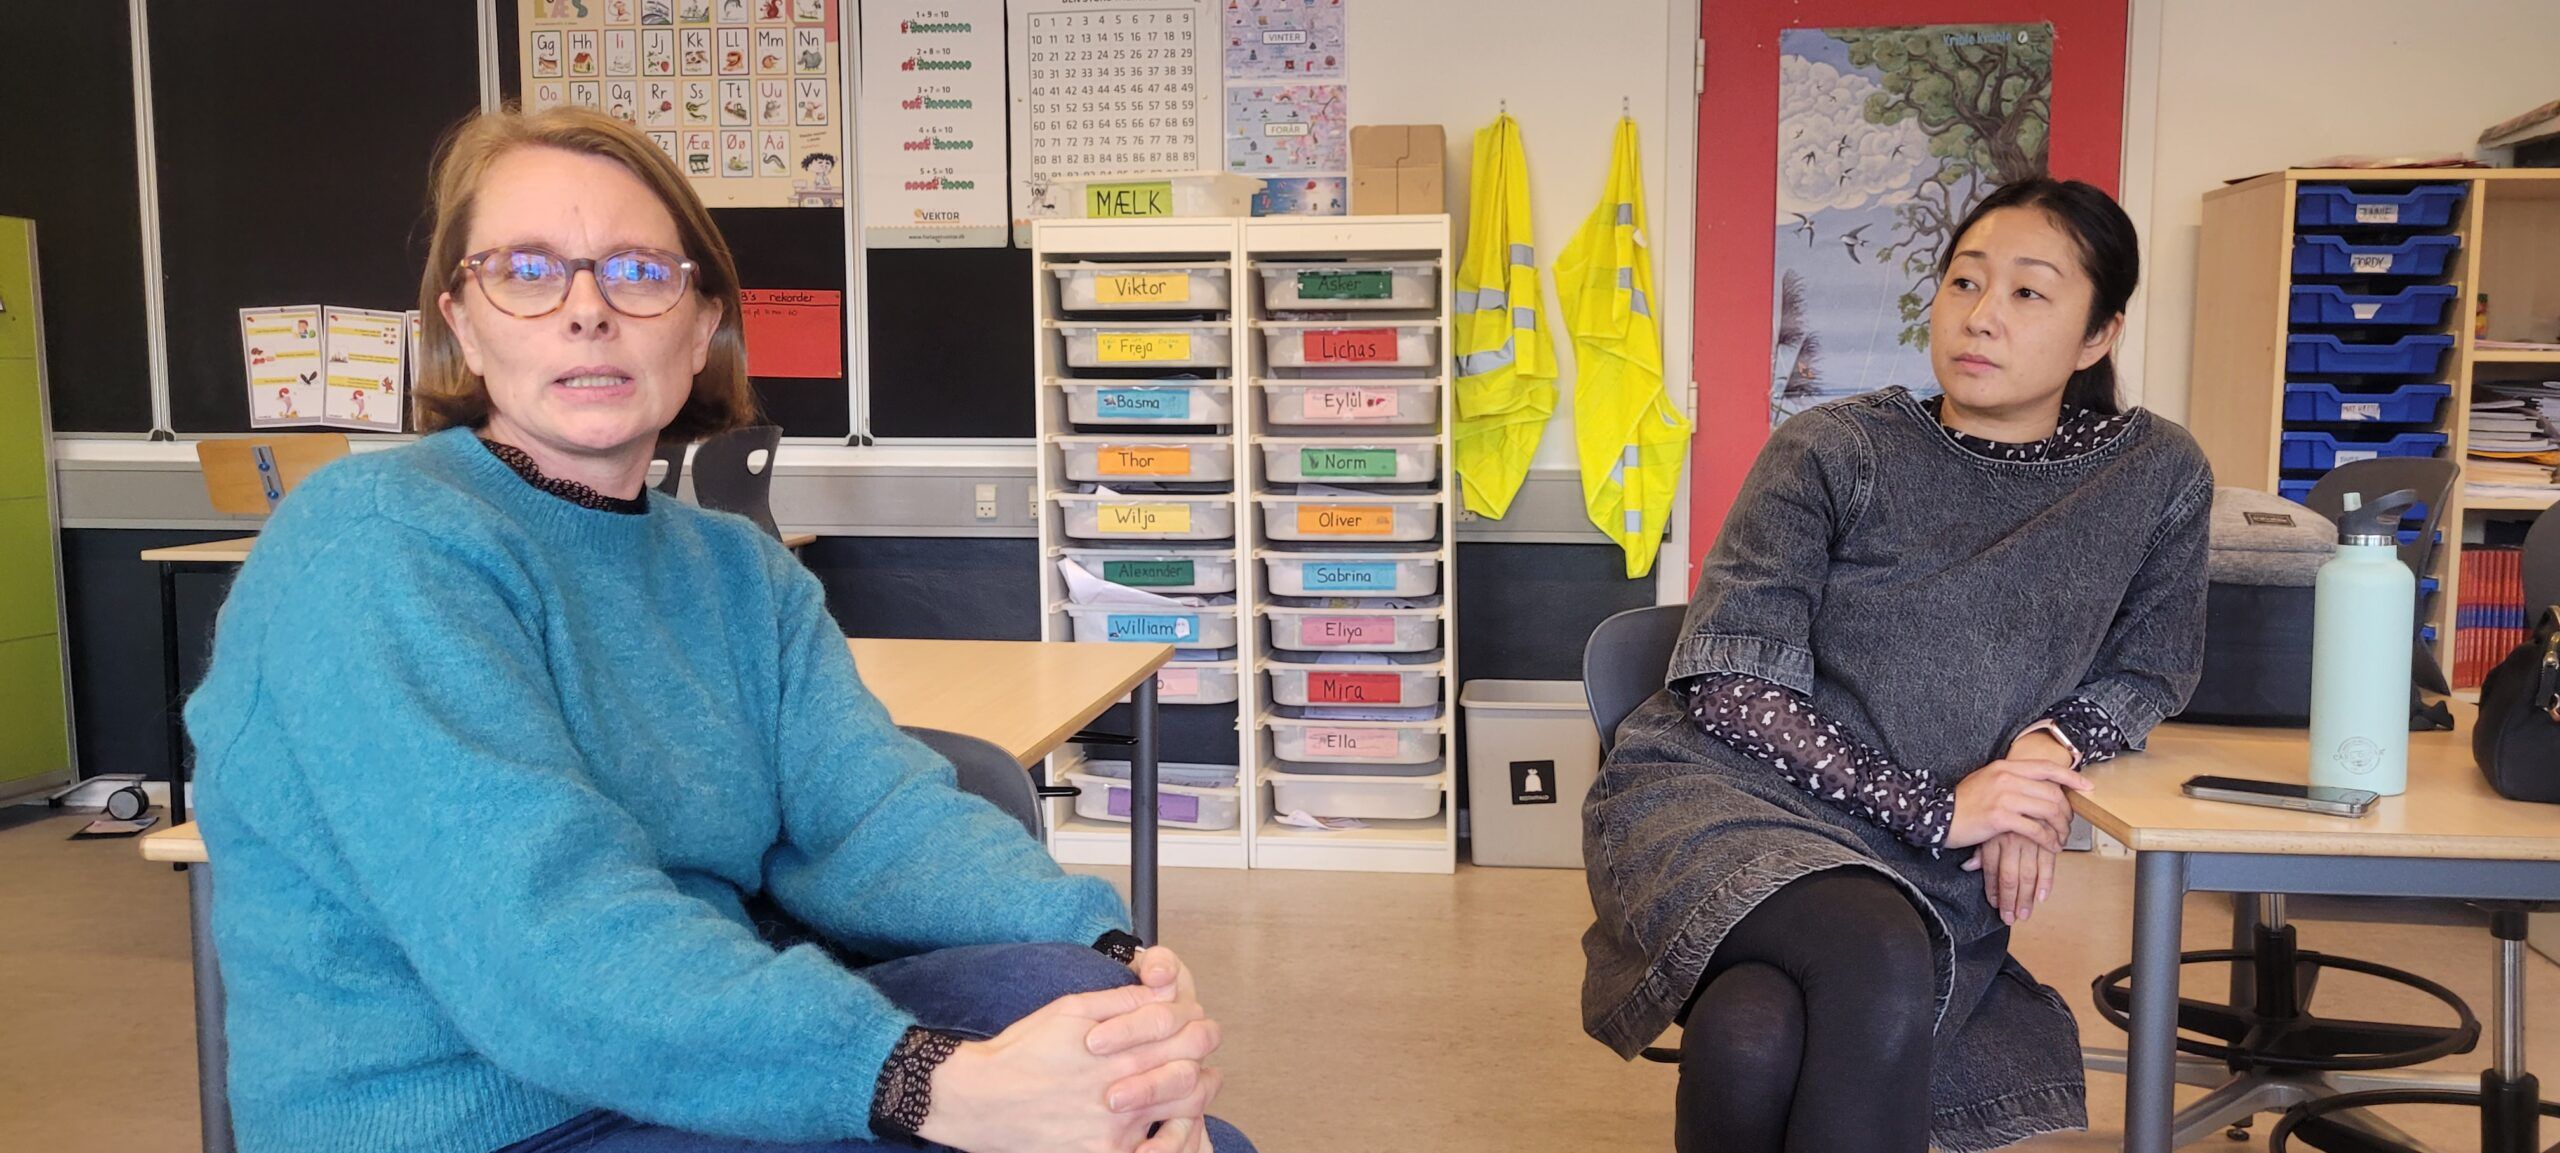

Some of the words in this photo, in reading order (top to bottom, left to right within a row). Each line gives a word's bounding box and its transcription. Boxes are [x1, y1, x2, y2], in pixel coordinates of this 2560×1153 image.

[1034, 18, 1040, 28] 0
[1051, 18, 1055, 26] 1
[1067, 16, 1072, 26] 2
[1083, 16, 1088, 26] 3
[1099, 16, 1104, 24] 4
[1116, 15, 1121, 24] 5
[1132, 14, 1138, 24] 6
[1149, 14, 1155, 23] 7
[1166, 14, 1172, 23] 8
[1183, 14, 1189, 22] 9
[537, 34, 555, 56] Gg
[573, 34, 592, 49] Hh
[616, 33, 624, 49] Ii
[651, 32, 664, 53] Jj
[687, 32, 703, 47] Kk
[726, 32, 739, 47] Ll
[758, 31, 784, 47] Mm
[800, 31, 818, 46] Nn
[1032, 35, 1042, 44] 10
[1050, 35, 1057, 44] 11
[1065, 34, 1074, 43] 12
[1082, 33, 1091, 43] 13
[1098, 33, 1107, 42] 14
[1114, 32, 1124, 42] 15
[1131, 32, 1141, 41] 16
[1148, 32, 1158, 40] 17
[1164, 32, 1174, 40] 18
[1182, 31, 1192, 40] 19
[1268, 33, 1301, 42] VINTER
[1032, 52, 1043, 62] 20
[1049, 52, 1058, 61] 21
[1065, 51, 1076, 61] 22
[1081, 51, 1092, 60] 23
[1098, 50, 1108, 60] 24
[1114, 50, 1125, 59] 25
[1130, 50, 1142, 59] 26
[1148, 49, 1158, 58] 27
[1164, 49, 1176, 58] 28
[1181, 48, 1192, 58] 29
[1032, 70, 1044, 79] 30
[1050, 69, 1059, 79] 31
[1066, 69, 1076, 78] 32
[1082, 68, 1092, 78] 33
[1098, 68, 1109, 77] 34
[1114, 67, 1125, 76] 35
[1131, 67, 1142, 76] 36
[1148, 66, 1159, 76] 37
[1165, 66, 1176, 76] 38
[1182, 66, 1193, 75] 39
[540, 85, 557, 101] Oo
[577, 84, 592, 105] Pp
[611, 84, 631, 105] Qq
[652, 84, 667, 99] Rr
[690, 83, 703, 99] Ss
[726, 83, 741, 98] Tt
[762, 83, 782, 98] Uu
[801, 82, 820, 97] Vv
[1032, 87, 1044, 96] 40
[1050, 87, 1060, 95] 41
[1065, 86, 1077, 95] 42
[1082, 86, 1093, 95] 43
[1098, 85, 1110, 93] 44
[1114, 84, 1126, 93] 45
[1131, 84, 1143, 93] 46
[1148, 84, 1160, 92] 47
[1164, 84, 1176, 92] 48
[1181, 83, 1193, 92] 49
[1034, 104, 1045, 114] 50
[1051, 104, 1060, 113] 51
[1066, 103, 1077, 112] 52
[1082, 102, 1094, 112] 53
[1099, 102, 1110, 111] 54
[1115, 102, 1126, 111] 55
[1132, 101, 1143, 111] 56
[1149, 101, 1160, 110] 57
[1165, 100, 1177, 110] 58
[1182, 100, 1194, 110] 59
[1034, 121, 1045, 130] 60
[1051, 121, 1060, 130] 61
[1066, 120, 1077, 130] 62
[1082, 120, 1094, 129] 63
[1099, 120, 1110, 128] 64
[1115, 119, 1127, 128] 65
[1132, 118, 1144, 128] 66
[1149, 118, 1160, 128] 67
[1165, 118, 1177, 127] 68
[1182, 118, 1194, 126] 69
[1270, 125, 1300, 134] FORÅR
[687, 134, 710, 150] Ææ
[727, 134, 745, 149] Øø
[765, 132, 785, 150] Åå
[1034, 138, 1046, 148] 70
[1051, 138, 1060, 146] 71
[1067, 137, 1077, 146] 72
[1083, 137, 1094, 146] 73
[1100, 136, 1110, 144] 74
[1116, 136, 1127, 145] 75
[1133, 136, 1144, 145] 76
[1150, 135, 1160, 144] 77
[1166, 135, 1177, 144] 78
[1184, 135, 1194, 144] 79
[1034, 155, 1046, 164] 80
[1052, 155, 1061, 164] 81
[1067, 154, 1078, 164] 82
[1084, 154, 1094, 163] 83
[1100, 154, 1112, 163] 84
[1116, 153, 1128, 162] 85
[1133, 153, 1145, 162] 86
[1150, 152, 1161, 162] 87
[1166, 152, 1178, 162] 88
[1183, 152, 1195, 161] 89
[1097, 190, 1161, 216] MÆLK
[922, 211, 960, 221] VEKTOR
[1115, 277, 1167, 297] Viktor
[769, 291, 815, 303] rekorder
[1120, 338, 1153, 359] Freja
[1322, 338, 1377, 359] Lichas
[1117, 394, 1159, 409] Basma
[1118, 452, 1154, 467] Thor
[1326, 454, 1366, 469] Norm
[1115, 507, 1155, 530] Wilja
[1319, 512, 1362, 527] Oliver
[1119, 564, 1183, 578] Alexander
[1317, 568, 1371, 583] Sabrina
[1115, 620, 1174, 636] William
[1326, 622, 1362, 643] Eliya
[1324, 679, 1364, 699] Mira
[1327, 734, 1356, 748] Ella
